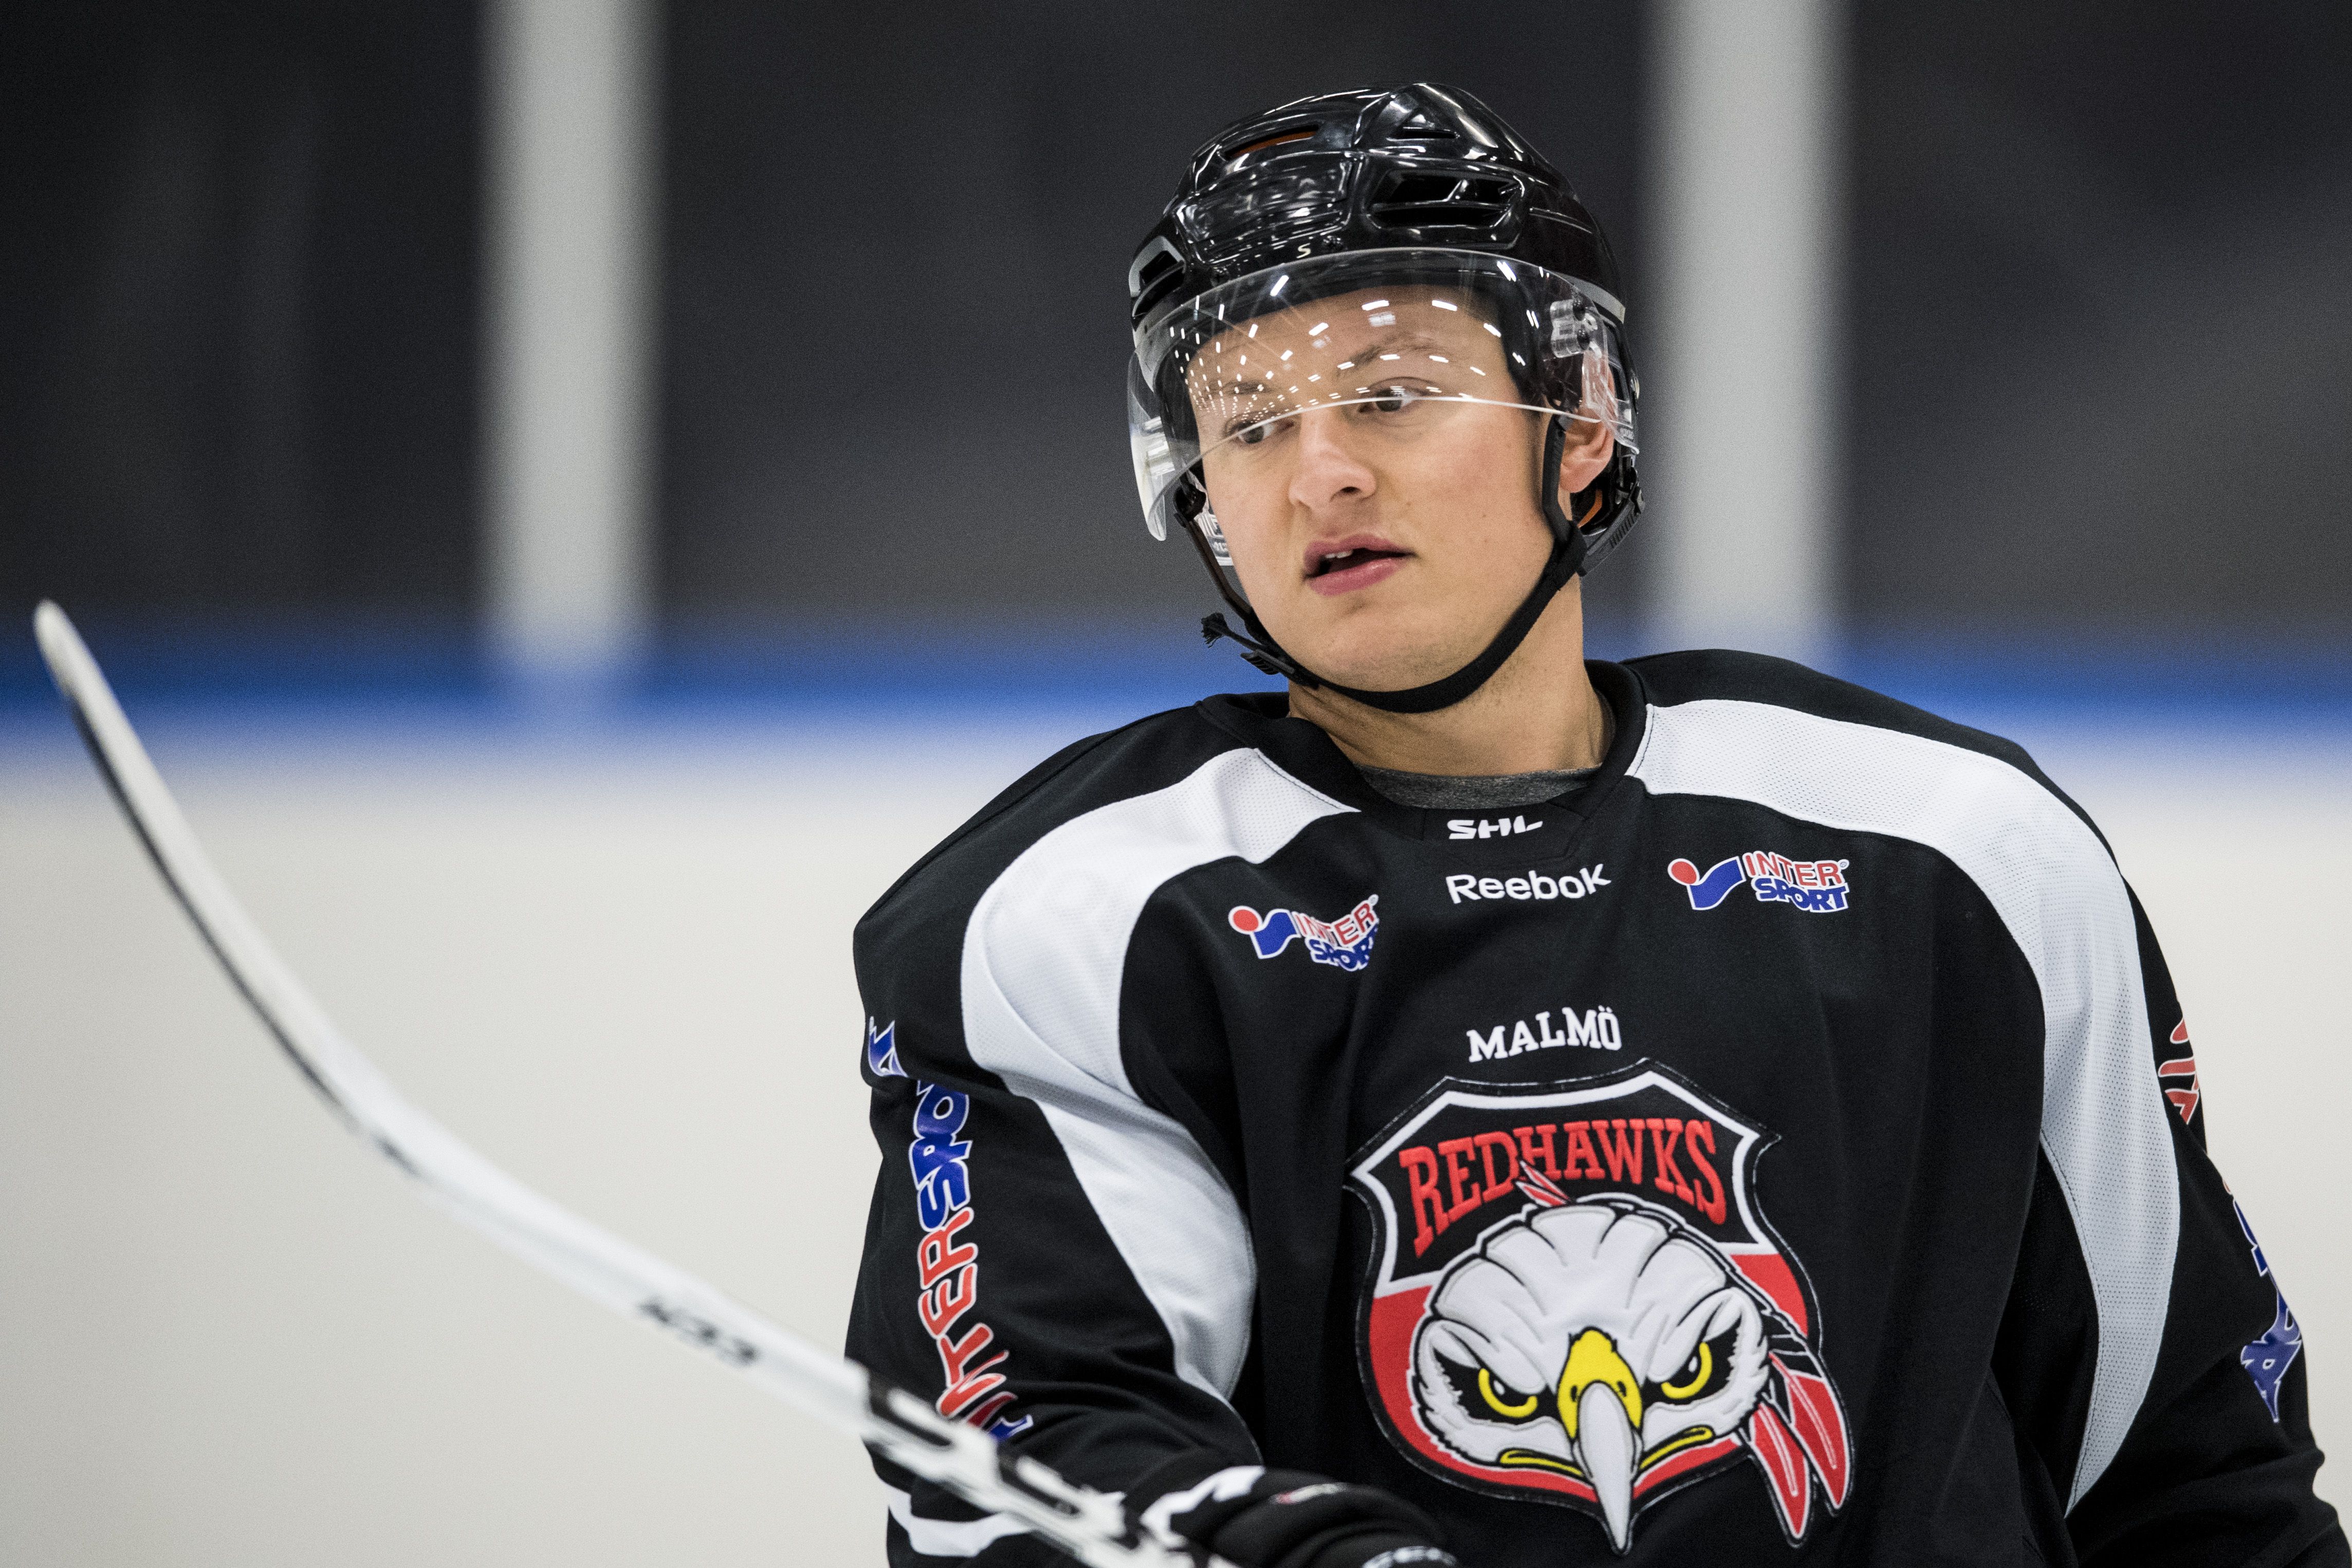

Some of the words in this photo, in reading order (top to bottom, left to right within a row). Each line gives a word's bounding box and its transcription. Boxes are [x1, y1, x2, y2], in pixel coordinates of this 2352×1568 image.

[1447, 815, 1542, 840] SHL
[1445, 864, 1611, 903] Reebok
[1742, 851, 1845, 888] INTER
[1751, 875, 1849, 913] SPORT
[1292, 900, 1379, 948] INTER
[1304, 925, 1379, 971] SPOR
[1466, 1005, 1622, 1062] MALMÖ
[1399, 1118, 1726, 1258] REDHAWKS
[868, 1016, 1018, 1430] INTERSPOT
